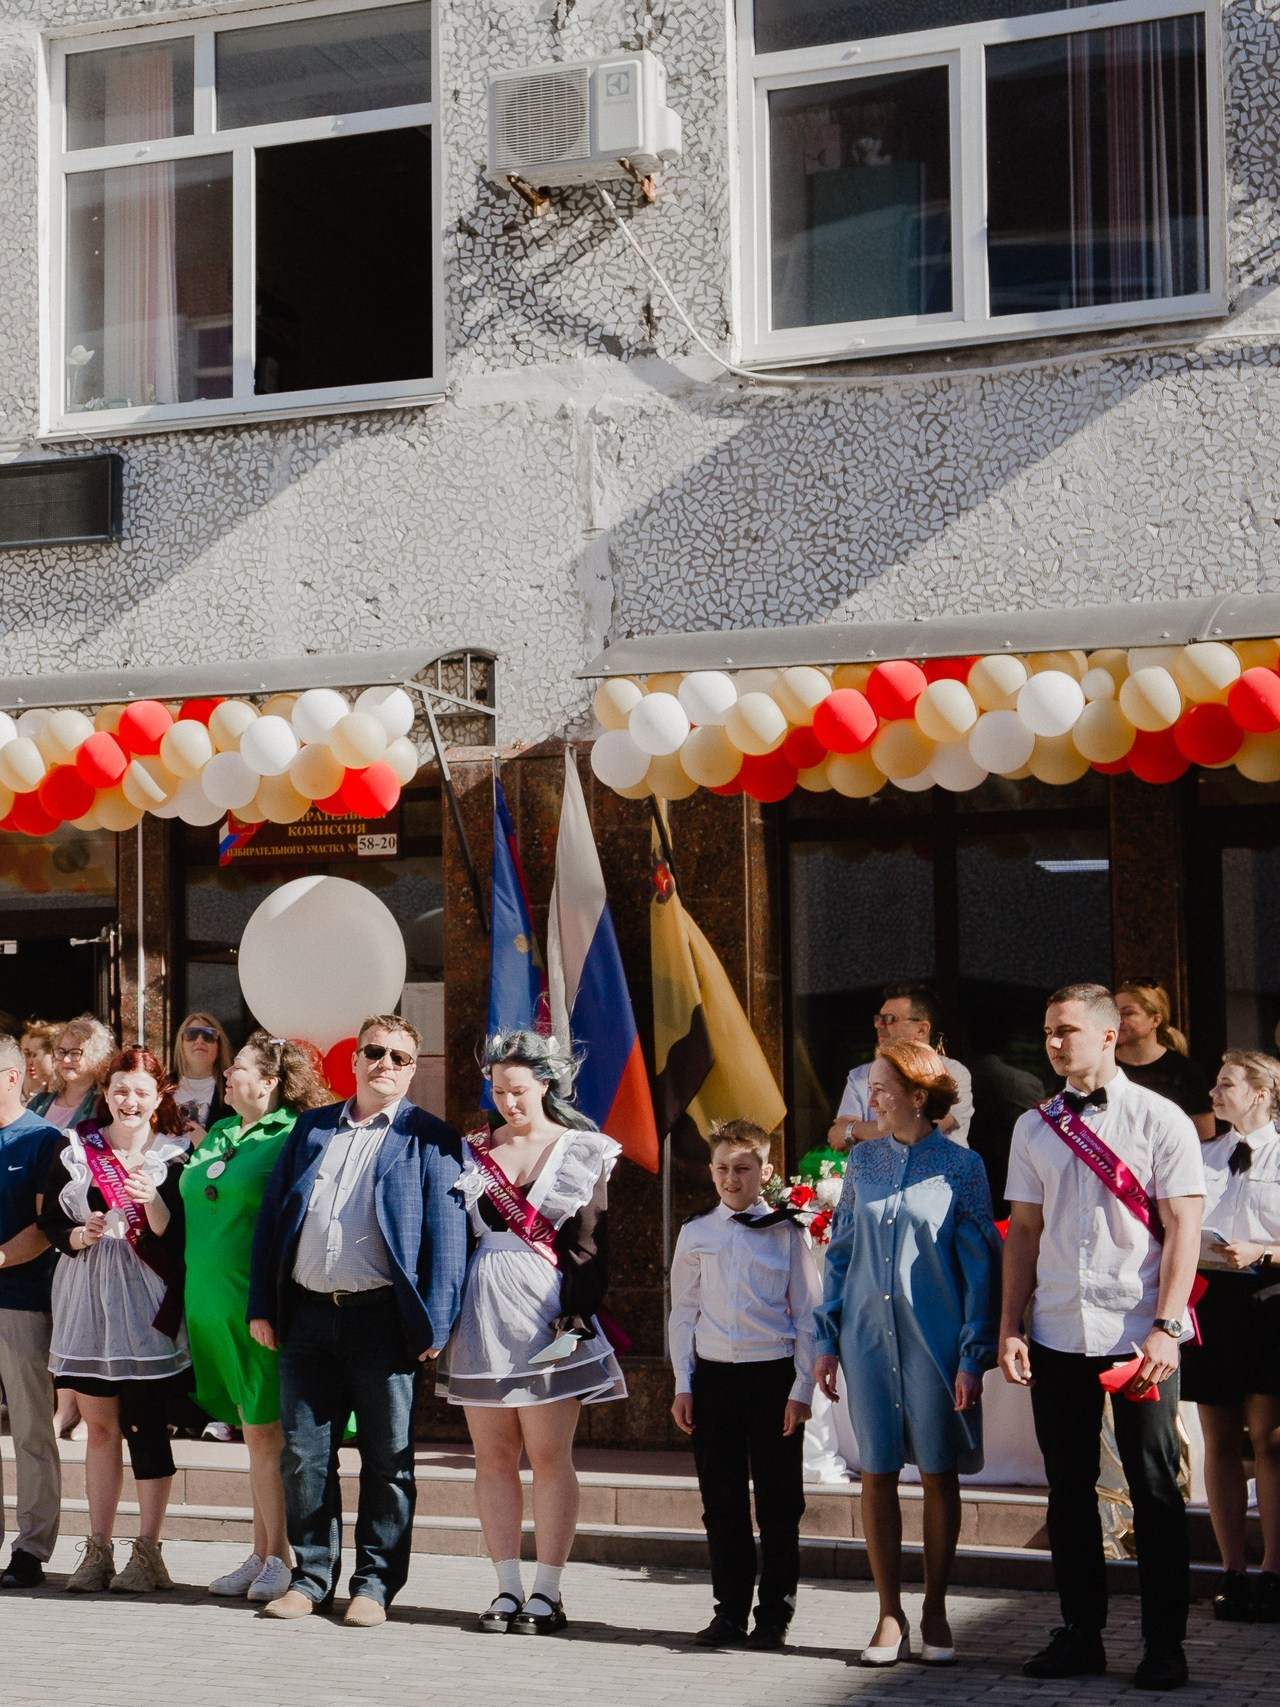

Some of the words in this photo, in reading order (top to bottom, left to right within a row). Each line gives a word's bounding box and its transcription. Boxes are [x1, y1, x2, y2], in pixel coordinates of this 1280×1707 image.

[288, 823, 367, 836] КОМИССИЯ
[226, 845, 304, 857] ИЗБИРАТЕЛЬНОГО
[306, 843, 345, 854] УЧАСТКА
[358, 836, 396, 851] 58-20
